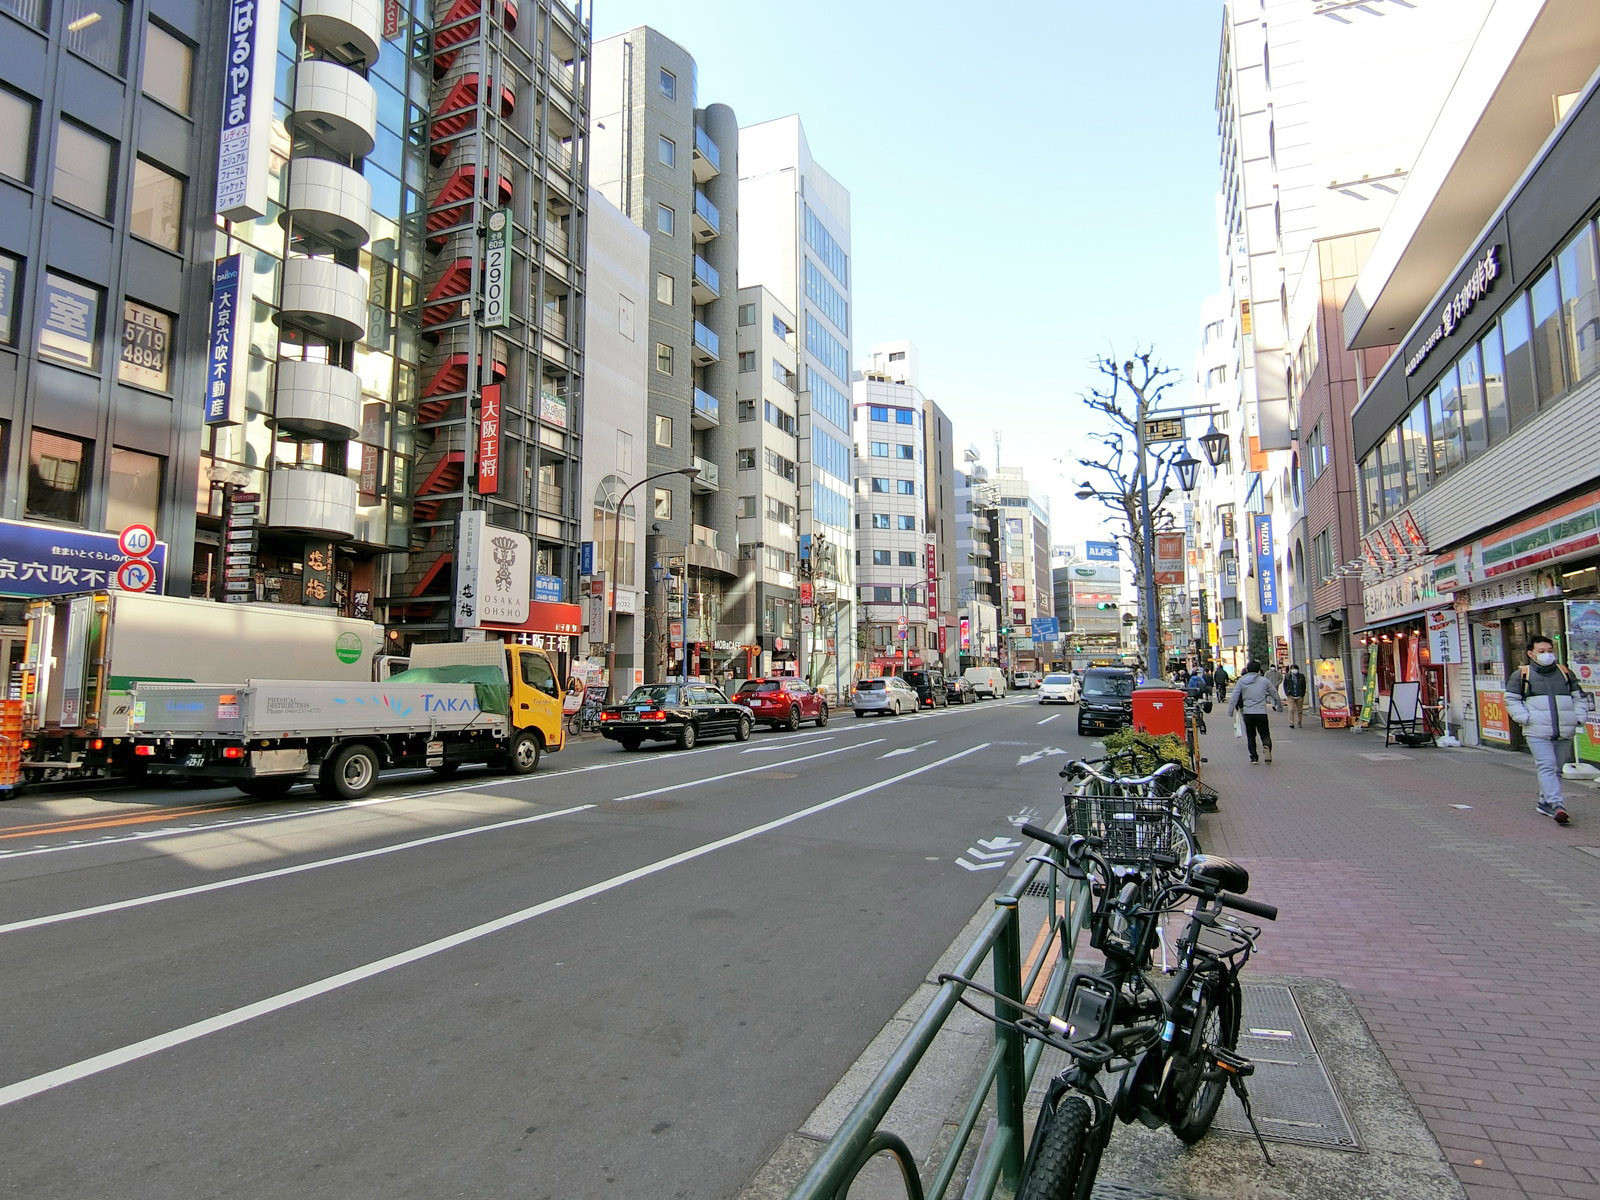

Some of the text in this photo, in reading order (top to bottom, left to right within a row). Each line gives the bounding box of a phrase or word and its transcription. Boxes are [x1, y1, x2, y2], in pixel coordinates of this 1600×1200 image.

[223, 127, 248, 142] レディス
[223, 139, 247, 154] スーツ
[222, 153, 246, 167] カジュアル
[221, 167, 246, 180] フォーマル
[220, 181, 244, 194] ジャケット
[219, 193, 243, 207] シャツ
[488, 252, 501, 316] 2900
[46, 292, 89, 337] 室
[131, 309, 163, 330] TEL
[125, 324, 164, 351] 5719
[123, 344, 162, 370] 4894
[210, 293, 232, 417] 大京穴吹不動産
[482, 401, 499, 478] 大阪王将
[127, 534, 148, 549] 40
[1088, 548, 1113, 556] ALPS
[1260, 522, 1273, 606] MIZUHO みずほ銀行
[484, 594, 521, 606] OSAKA
[484, 606, 521, 617] OHSHO
[517, 632, 570, 651] 大阪王将
[1438, 630, 1451, 663] 広州市場
